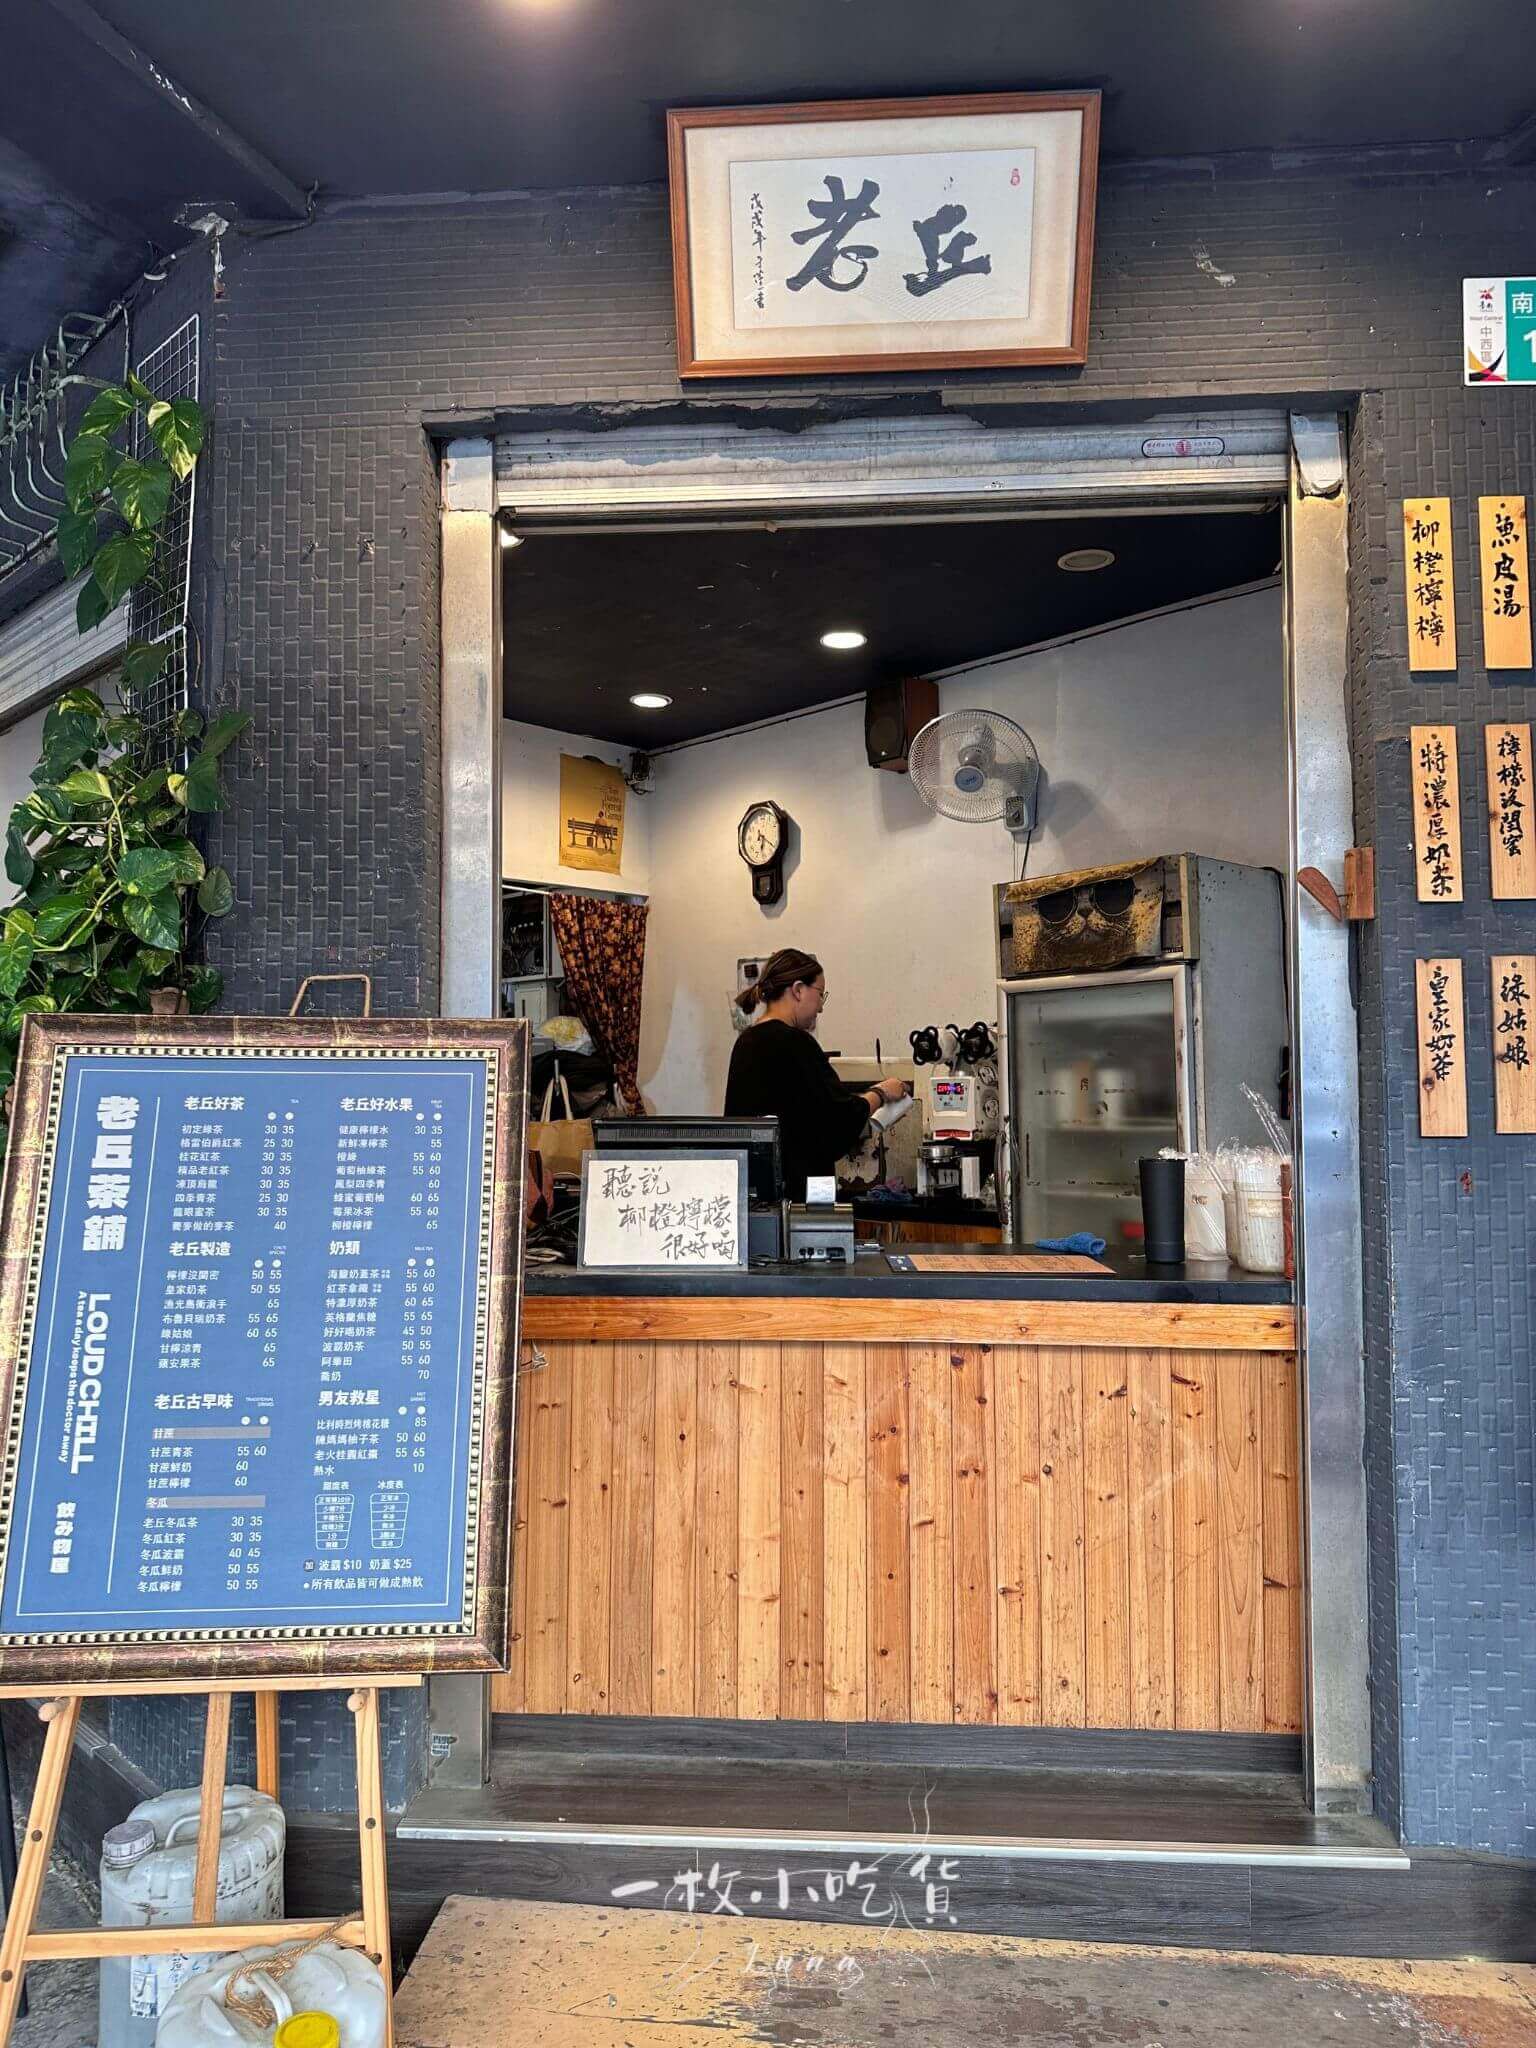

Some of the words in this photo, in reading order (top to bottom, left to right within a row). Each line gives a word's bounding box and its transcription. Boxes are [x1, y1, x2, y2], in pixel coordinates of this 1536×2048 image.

[1480, 325, 1492, 363] 中西區
[1491, 513, 1522, 618] 魚皮湯
[1420, 740, 1455, 896] 特濃厚奶茶
[1425, 970, 1457, 1081] 皇家奶茶
[1496, 974, 1530, 1071] 綠姑娘
[184, 1096, 244, 1110] 老丘好茶
[341, 1097, 413, 1111] 老丘好水果
[265, 1125, 277, 1134] 30
[283, 1126, 294, 1134] 35
[415, 1126, 426, 1134] 30
[432, 1126, 442, 1134] 35
[264, 1139, 275, 1147] 25
[281, 1139, 293, 1147] 30
[431, 1139, 441, 1147] 55
[262, 1153, 274, 1161] 30
[280, 1152, 291, 1161] 35
[414, 1152, 424, 1161] 55
[430, 1153, 441, 1161] 60
[261, 1166, 273, 1175] 30
[279, 1166, 291, 1175] 35
[413, 1166, 423, 1175] 55
[428, 1166, 440, 1175] 60
[260, 1180, 272, 1188] 30
[278, 1180, 289, 1188] 35
[429, 1179, 439, 1188] 60
[602, 1165, 670, 1200] 聽說
[259, 1193, 270, 1202] 25
[277, 1193, 288, 1202] 30
[411, 1193, 422, 1202] 60
[428, 1193, 439, 1201] 65
[257, 1207, 269, 1216] 30
[275, 1207, 287, 1216] 35
[411, 1207, 421, 1215] 55
[427, 1207, 438, 1216] 60
[274, 1221, 286, 1230] 40
[427, 1220, 437, 1229] 65
[170, 1241, 230, 1256] 老丘製造
[330, 1241, 360, 1255] 奶類
[252, 1270, 264, 1279] 50
[270, 1270, 281, 1279] 55
[407, 1269, 417, 1278] 55
[424, 1269, 435, 1278] 60
[165, 1285, 207, 1295] 皇家奶茶
[251, 1285, 262, 1293] 50
[269, 1284, 280, 1293] 55
[406, 1283, 417, 1292] 55
[423, 1283, 434, 1292] 60
[268, 1299, 279, 1308] 65
[405, 1297, 416, 1306] 60
[422, 1297, 433, 1306] 65
[249, 1314, 260, 1323] 55
[266, 1313, 278, 1322] 65
[404, 1312, 415, 1321] 55
[421, 1312, 432, 1320] 65
[247, 1328, 259, 1337] 60
[265, 1328, 277, 1337] 65
[403, 1326, 414, 1335] 45
[421, 1326, 432, 1335] 50
[71, 1327, 84, 1346] day
[264, 1343, 275, 1352] 65
[402, 1341, 413, 1350] 50
[420, 1341, 431, 1349] 55
[68, 1346, 81, 1378] keeps
[263, 1358, 274, 1366] 65
[401, 1356, 412, 1364] 55
[419, 1355, 430, 1364] 60
[418, 1370, 429, 1379] 70
[67, 1379, 79, 1397] the
[155, 1393, 233, 1409] 老丘古早味
[319, 1390, 379, 1406] 男友救星
[62, 1398, 76, 1434] doctor
[415, 1417, 426, 1427] 85
[153, 1428, 175, 1439] 甘蔗
[397, 1432, 408, 1442] 50
[414, 1432, 425, 1442] 60
[58, 1435, 70, 1463] away
[238, 1447, 249, 1456] 55
[255, 1446, 266, 1455] 60
[396, 1448, 407, 1457] 55
[413, 1448, 424, 1457] 65
[236, 1461, 248, 1470] 60
[314, 1465, 334, 1476] 熱水
[414, 1463, 424, 1472] 10
[235, 1476, 247, 1486] 60
[146, 1497, 168, 1509] 冬瓜
[143, 1517, 198, 1528] 老丘冬瓜茶
[232, 1517, 244, 1526] 30
[250, 1516, 262, 1526] 35
[143, 1533, 186, 1544] 冬瓜紅茶
[230, 1532, 243, 1542] 30
[249, 1532, 261, 1541] 35
[229, 1548, 241, 1558] 40
[248, 1548, 260, 1557] 45
[344, 1559, 361, 1570] $10
[393, 1559, 411, 1569] $25
[139, 1565, 182, 1576] 冬瓜鮮奶
[228, 1564, 240, 1574] 50
[247, 1564, 259, 1573] 55
[227, 1580, 239, 1590] 50
[246, 1580, 257, 1589] 55
